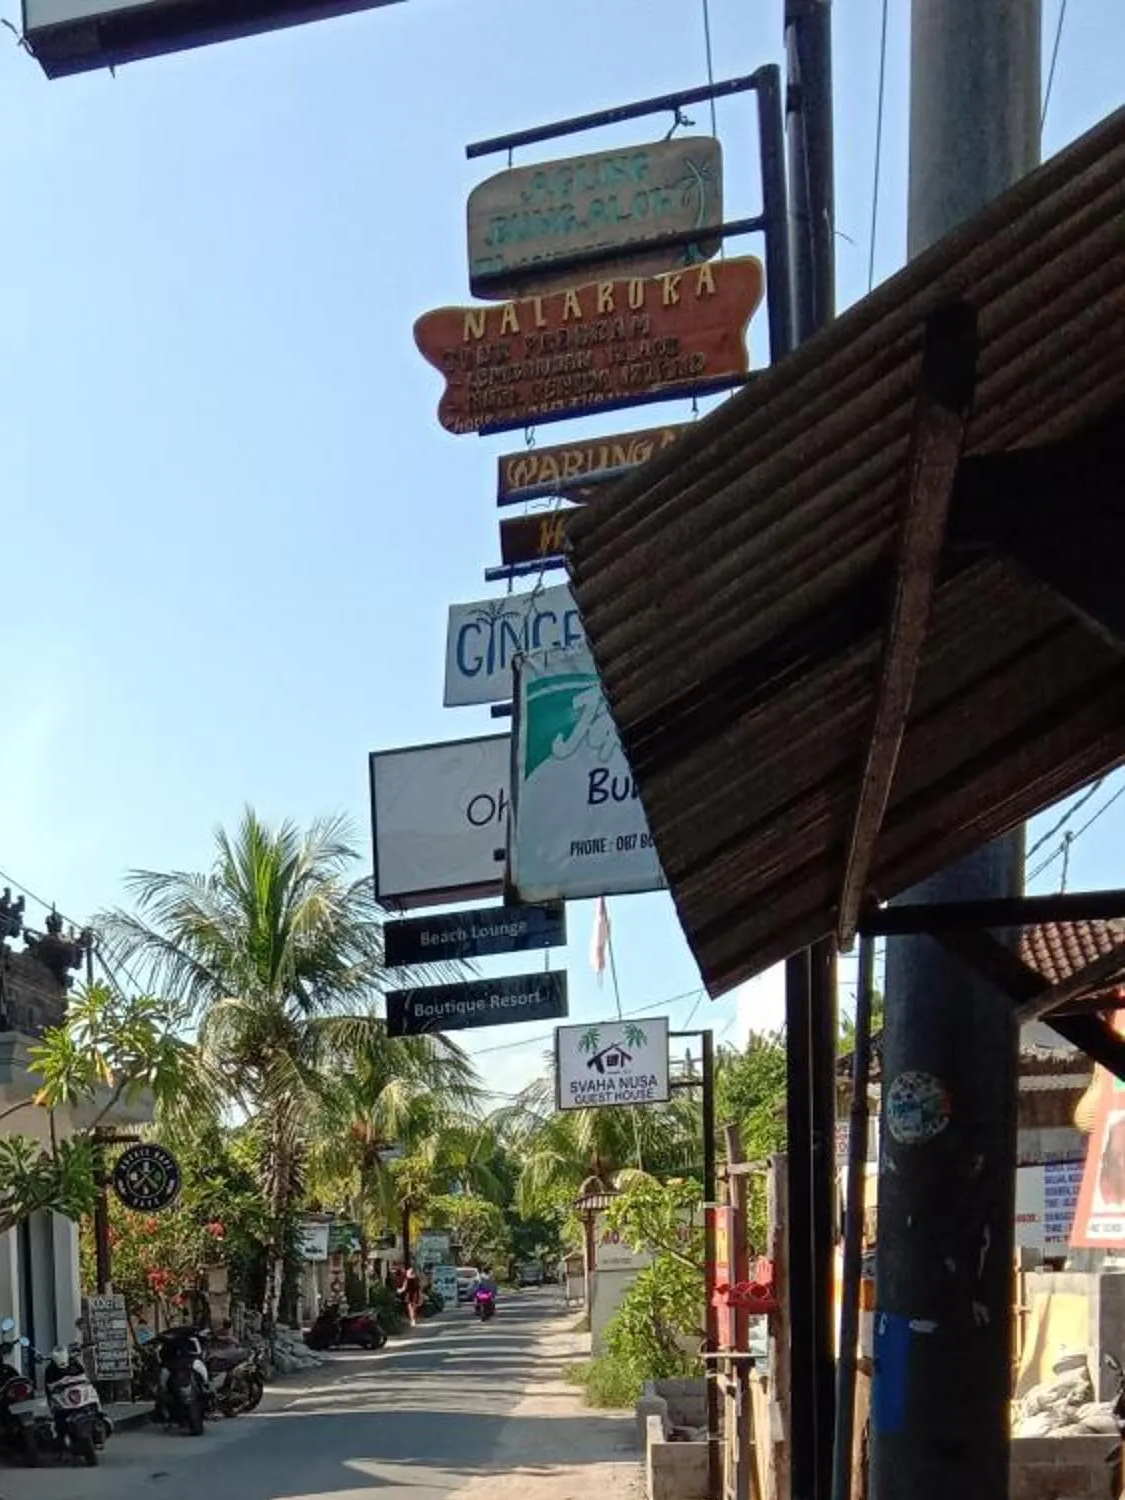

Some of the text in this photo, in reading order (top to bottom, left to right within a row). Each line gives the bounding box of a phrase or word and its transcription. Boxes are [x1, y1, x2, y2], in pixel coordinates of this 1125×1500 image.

[462, 265, 716, 341] NALARUKA
[506, 440, 653, 488] WARUNG
[420, 920, 527, 946] Beach Lounge
[414, 991, 541, 1017] Boutique Resort
[570, 1074, 658, 1094] SVAHA NUSA
[615, 1087, 655, 1100] HOUSE
